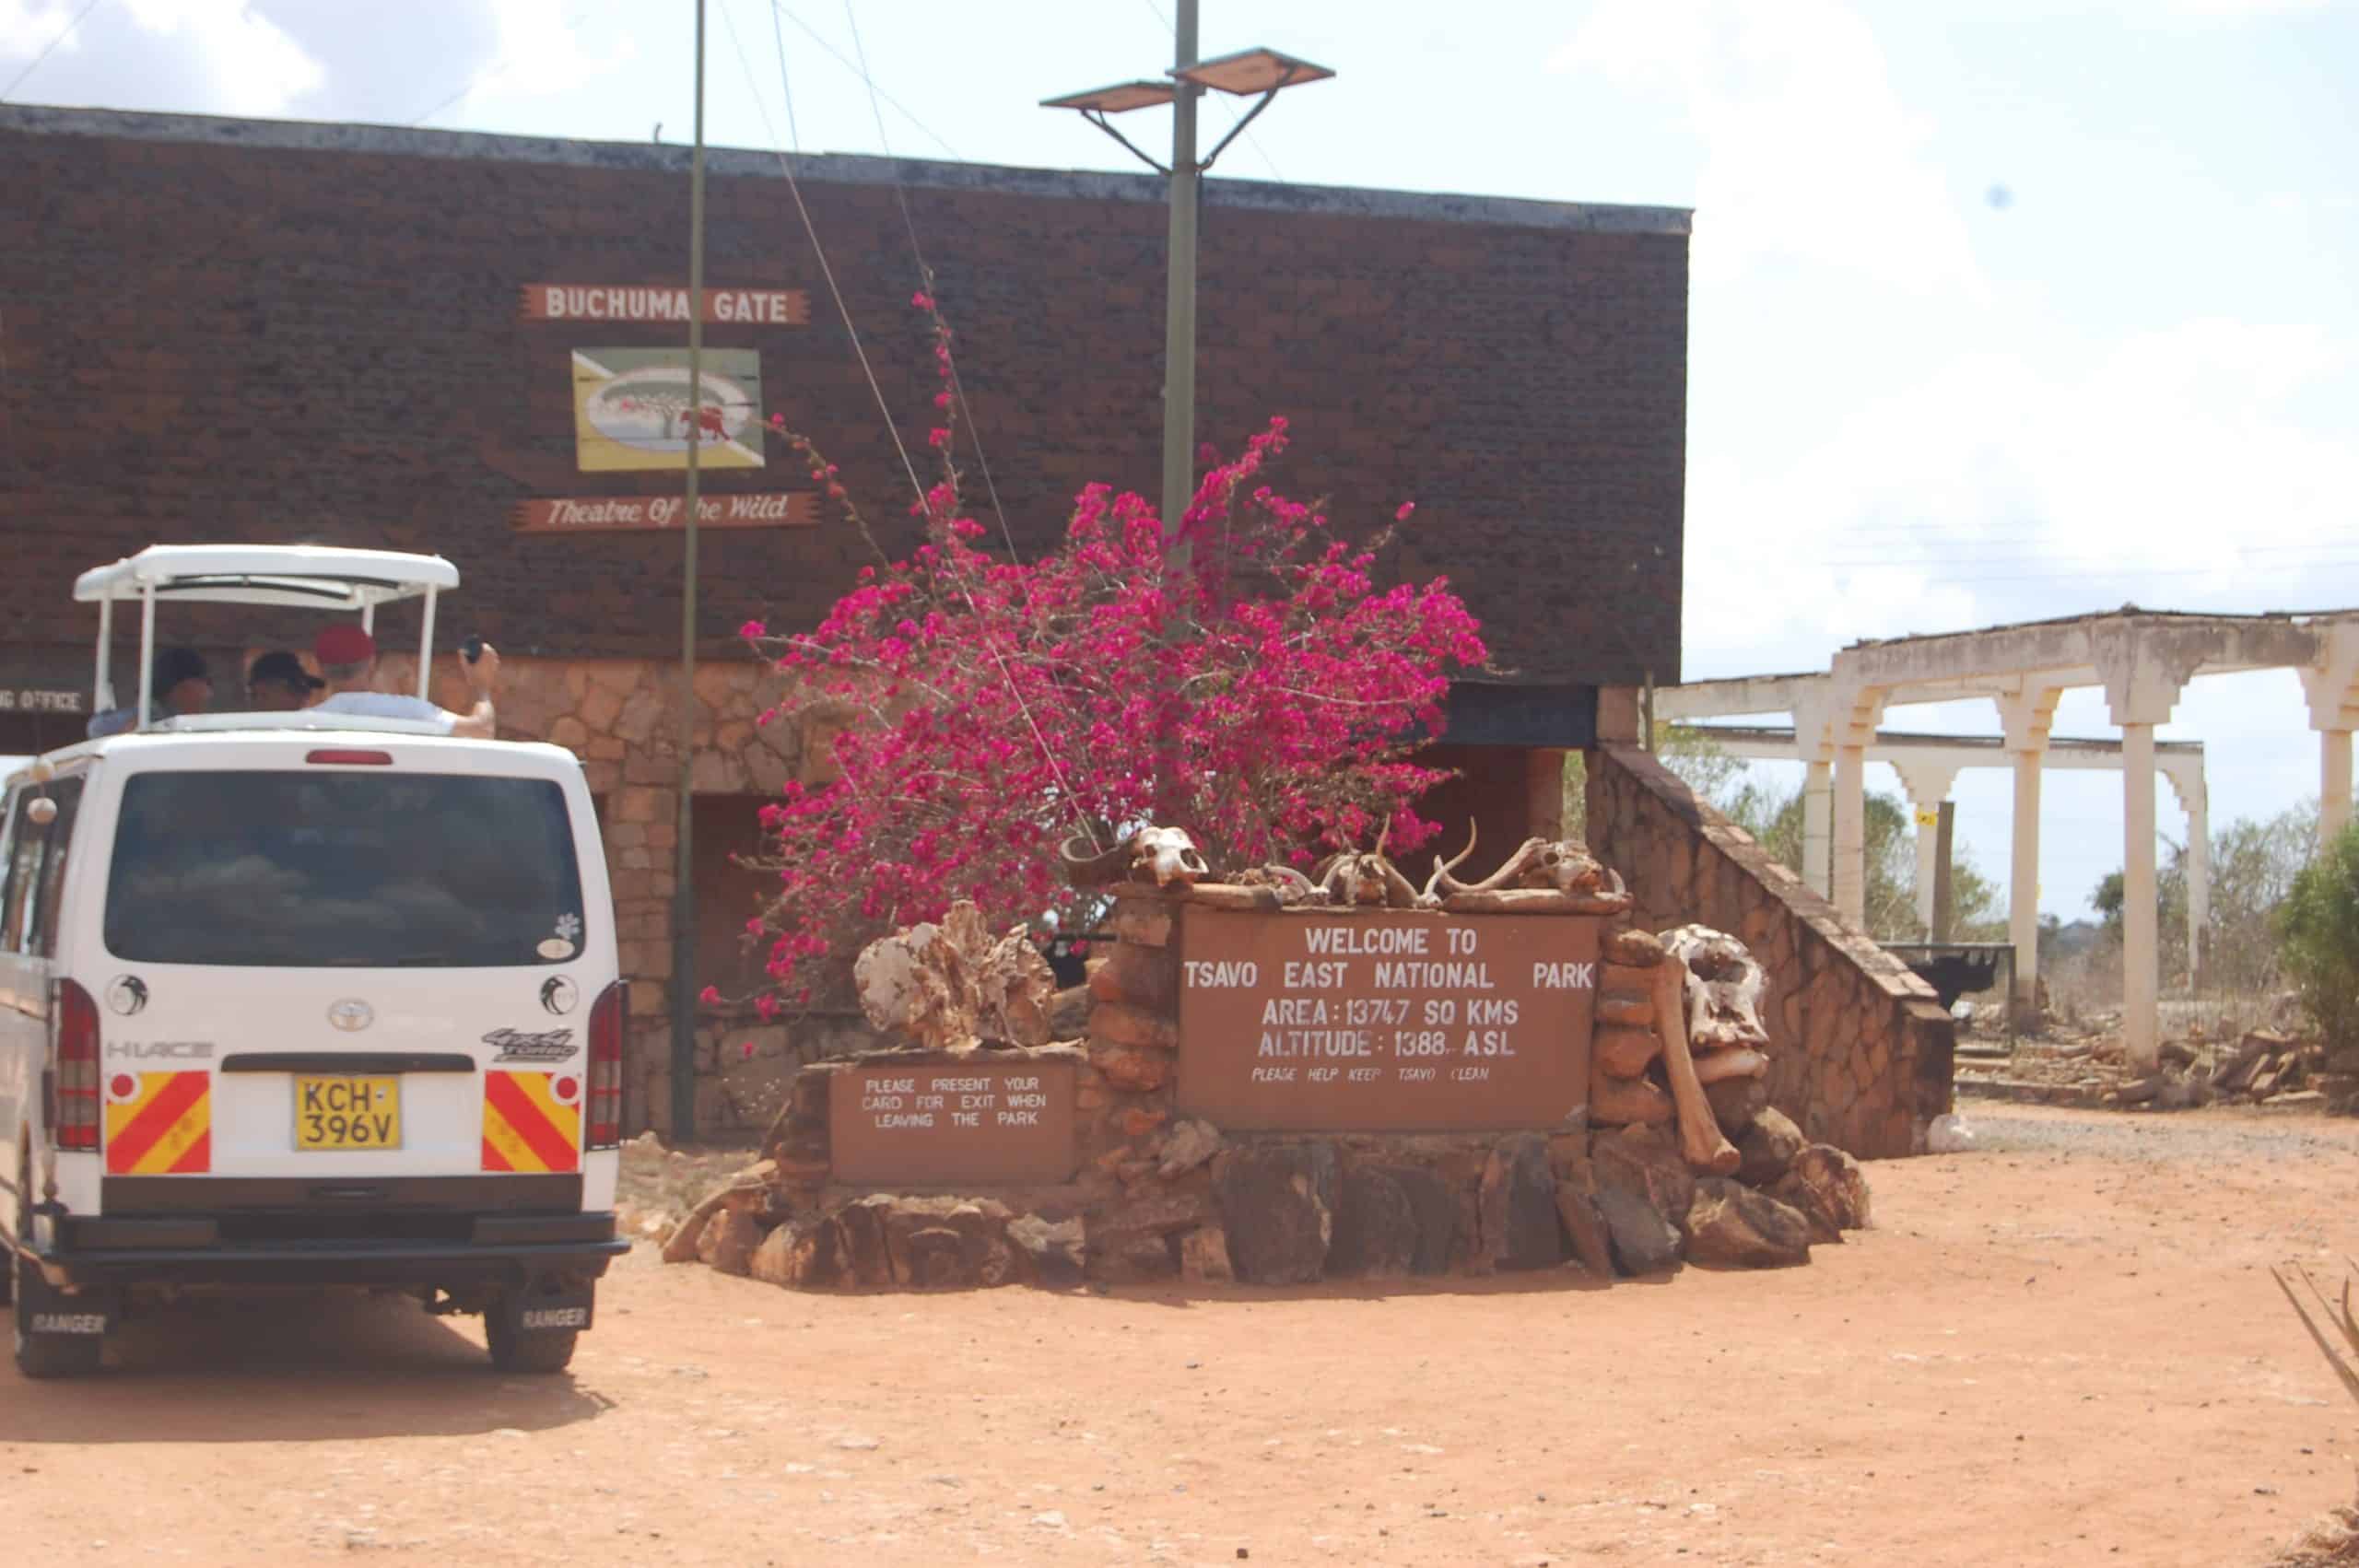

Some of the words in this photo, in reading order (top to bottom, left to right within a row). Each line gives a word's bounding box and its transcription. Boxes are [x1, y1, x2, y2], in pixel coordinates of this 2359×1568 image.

[546, 287, 690, 319] BUCHUMA
[714, 293, 788, 322] GATE
[547, 499, 641, 524] Theatre
[648, 497, 681, 525] Of
[693, 497, 722, 521] he
[730, 495, 788, 521] Wild
[19, 690, 82, 710] OFFICE
[1306, 928, 1429, 954] WELCOME
[1448, 928, 1477, 954] TO
[1184, 961, 1257, 989] TSAVO
[1284, 961, 1348, 989] EAST
[1375, 961, 1495, 989] NATIONAL
[1533, 962, 1594, 989] PARK
[1466, 999, 1520, 1025] KMS
[1463, 1029, 1516, 1057] ASL
[865, 1078, 915, 1094] PLEASE
[931, 1077, 992, 1093] PRESENT
[1003, 1076, 1040, 1091] YOUR
[1251, 1067, 1297, 1082] PLEASE
[1308, 1067, 1340, 1082] HELP
[1347, 1067, 1382, 1082] KEEP
[304, 1082, 370, 1112] KCH
[862, 1095, 903, 1111] CARD
[915, 1094, 945, 1109] FOR
[960, 1094, 996, 1108] EXIT
[1006, 1093, 1047, 1107] WHEN
[305, 1114, 392, 1143] 396V
[875, 1113, 933, 1129] LEAVING
[950, 1111, 980, 1127] THE
[997, 1110, 1039, 1126] PARK
[32, 1314, 107, 1334] RANGER
[522, 1307, 587, 1329] RANGER
